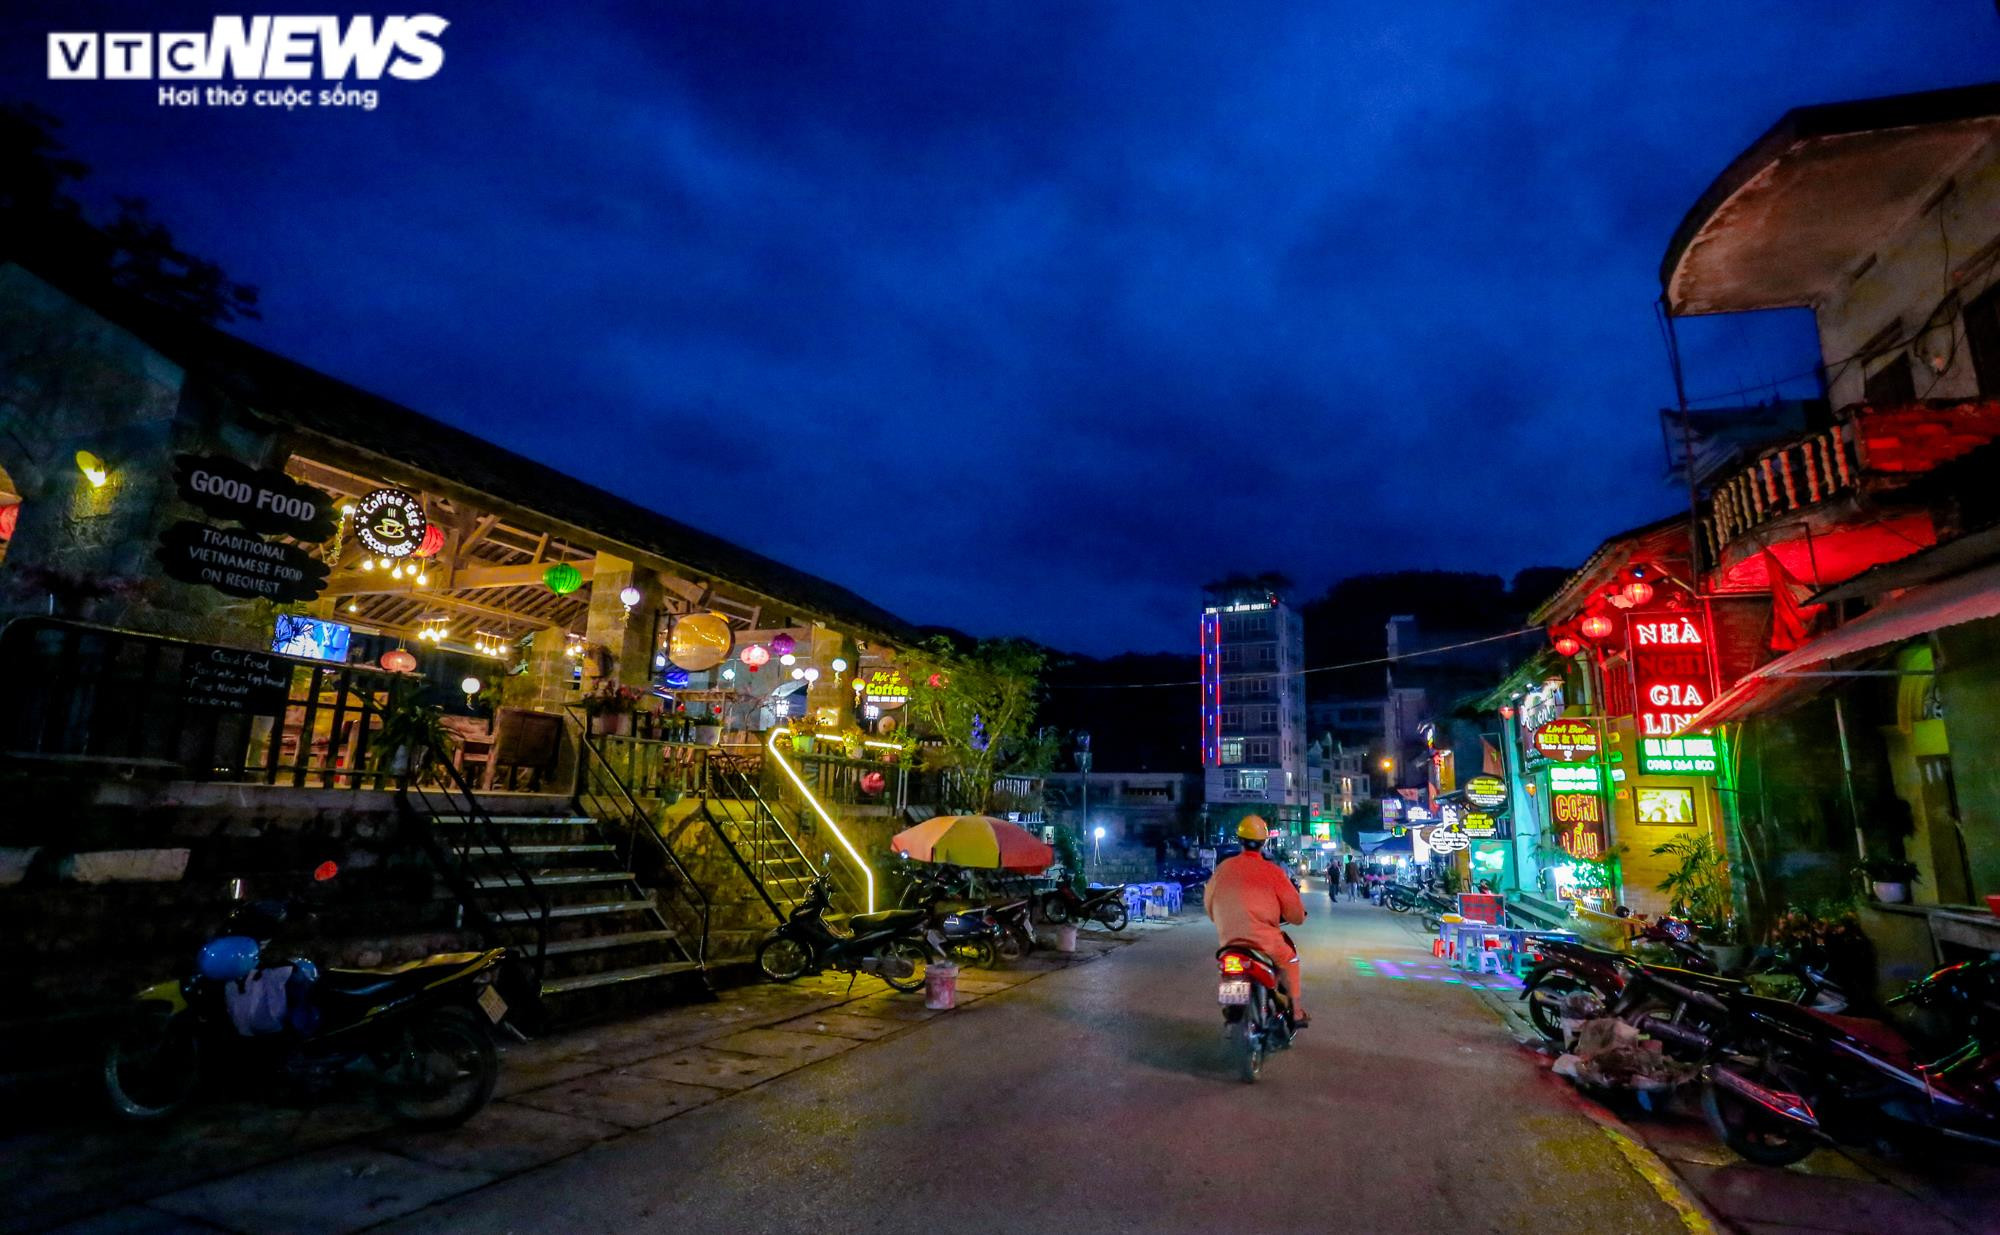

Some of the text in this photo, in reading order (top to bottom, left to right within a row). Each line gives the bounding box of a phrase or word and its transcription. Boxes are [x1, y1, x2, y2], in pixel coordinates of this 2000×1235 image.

[190, 470, 316, 521] GOOD FOOD
[362, 493, 420, 527] Coffee Egg
[202, 529, 285, 561] TRADITIONAL
[189, 546, 303, 581] VIETNAMESE FOOD
[201, 568, 280, 594] ON REQUEST
[1636, 617, 1702, 645] NHÀ
[866, 683, 909, 696] Coffee
[1650, 684, 1703, 706] GIA
[1538, 733, 1596, 745] BEER & WINE
[1568, 724, 1588, 734] Bar
